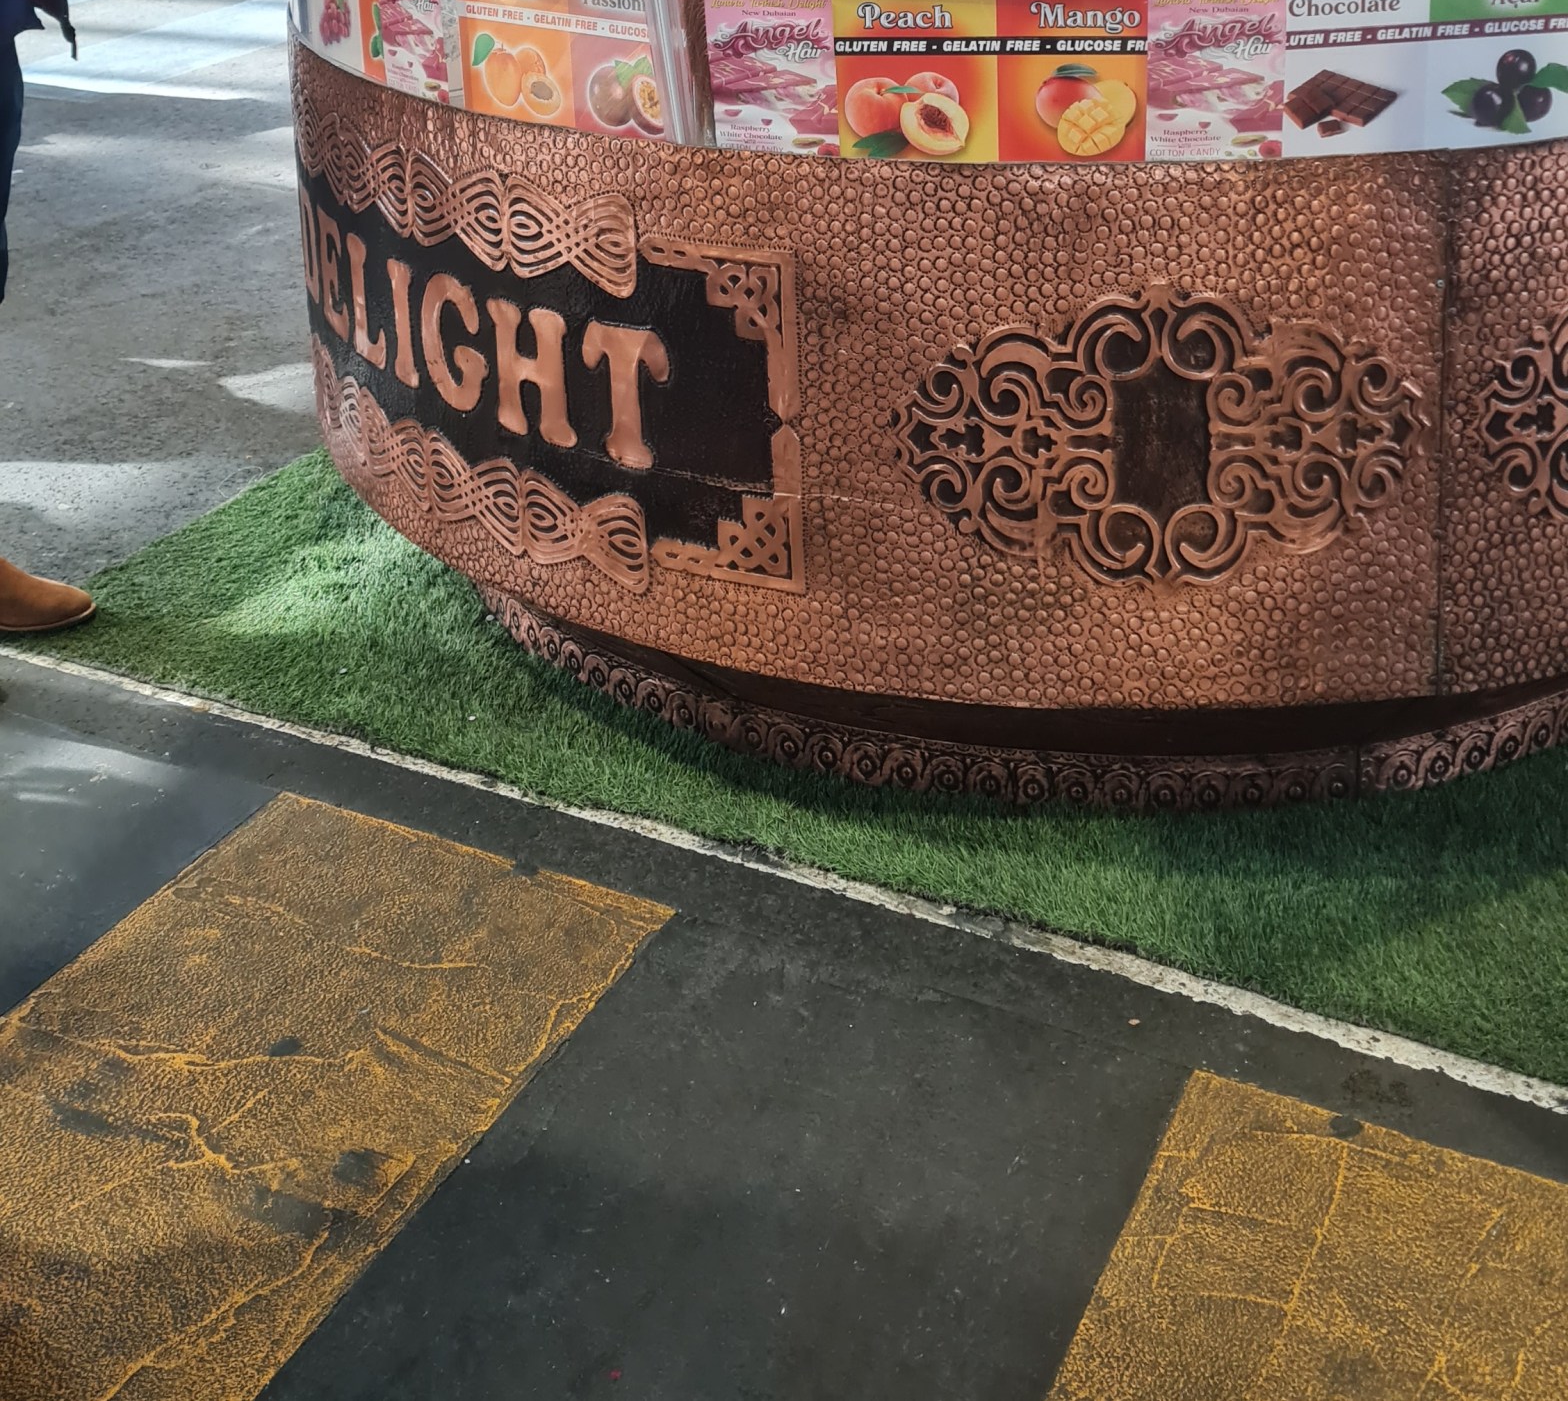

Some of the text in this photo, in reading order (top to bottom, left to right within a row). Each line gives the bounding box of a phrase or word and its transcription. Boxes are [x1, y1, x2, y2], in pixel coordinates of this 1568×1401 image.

[466, 4, 498, 17] GLUTEN
[502, 9, 524, 21] FREE
[533, 14, 572, 27] GELATIN
[575, 19, 598, 31] FREE
[608, 24, 649, 38] GLUCOS
[857, 1, 953, 29] Peach
[1030, 1, 1141, 34] Mango
[715, 18, 826, 50] Angel
[1157, 13, 1277, 48] Angel
[1329, 31, 1362, 44] FREE
[1377, 27, 1433, 41] GELATIN
[1437, 24, 1470, 37] FREE
[1484, 19, 1545, 33] GLUCOSE
[776, 41, 826, 62] Hair
[835, 40, 888, 53] GLUTEN
[893, 40, 927, 52] FREE
[943, 40, 1001, 52] GELATIN
[1006, 40, 1041, 51] FREE
[1056, 40, 1121, 51] GLUCOSE
[1223, 36, 1275, 60] Hair
[731, 124, 771, 133] Raspberry
[1163, 129, 1208, 137] Raspberry
[1190, 147, 1221, 156] CANDY
[300, 176, 670, 470] DELIGHT
